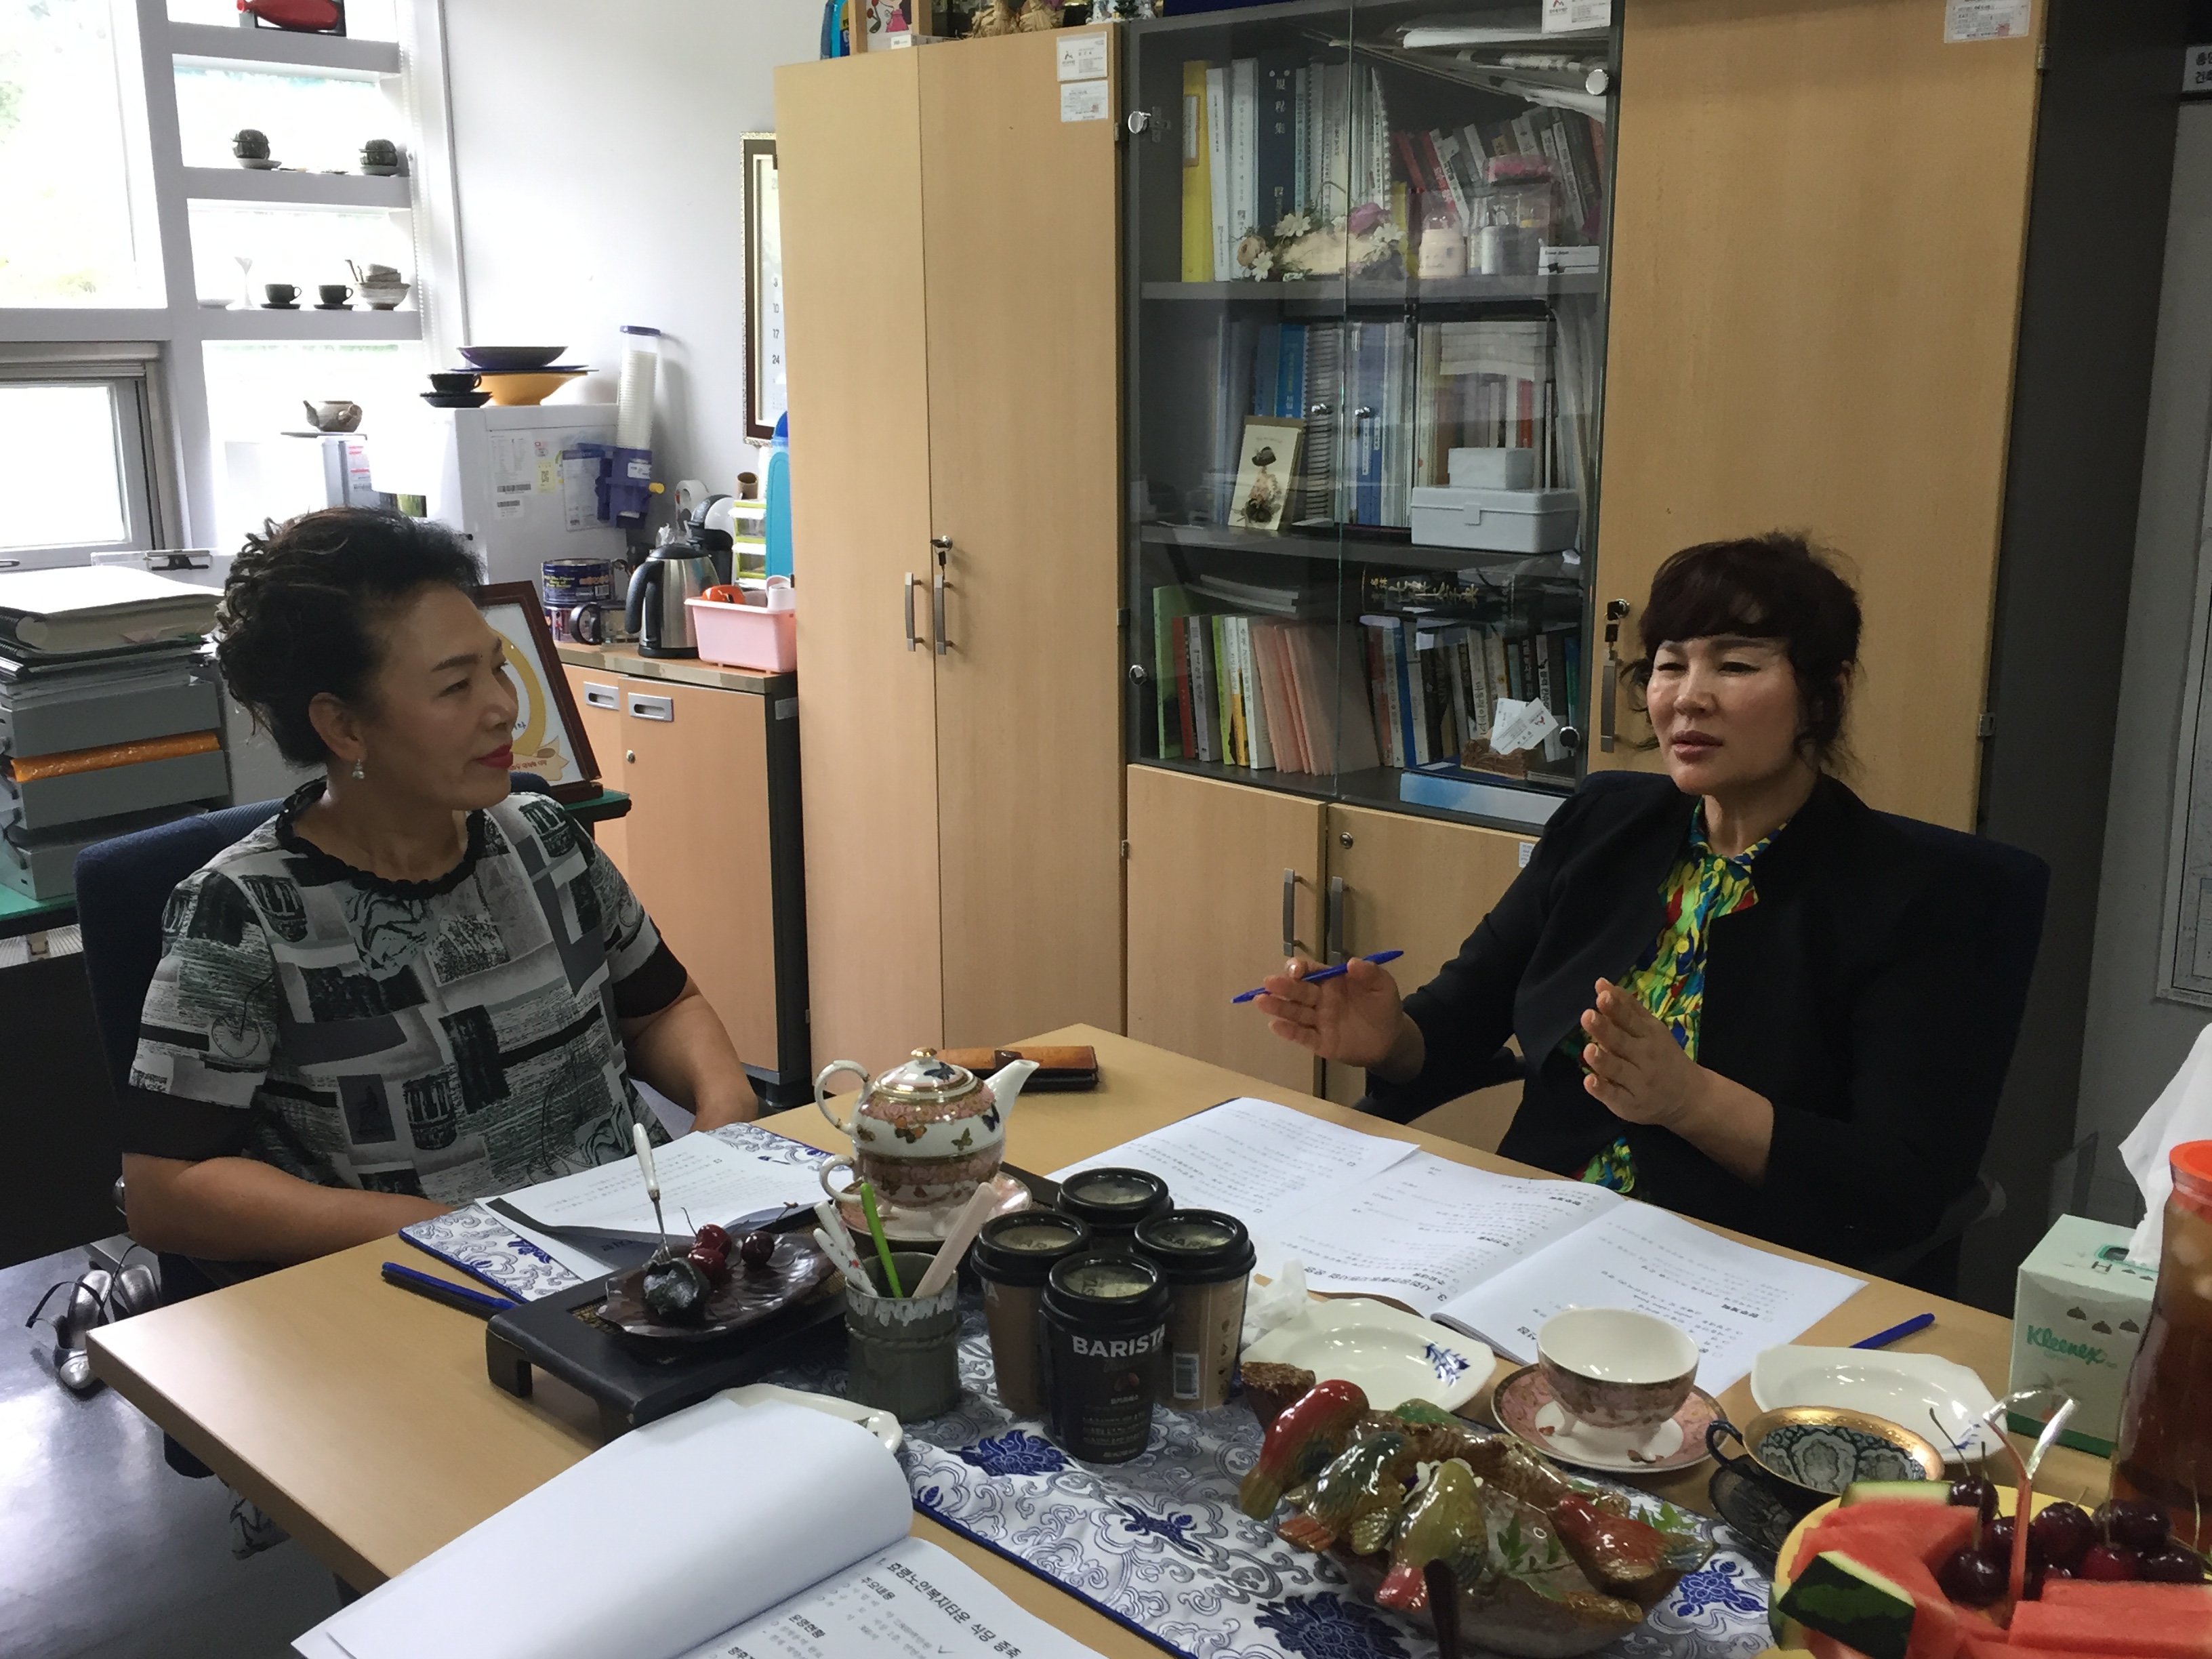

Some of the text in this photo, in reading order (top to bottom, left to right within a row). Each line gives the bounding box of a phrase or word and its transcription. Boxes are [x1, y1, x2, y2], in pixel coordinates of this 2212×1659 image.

[773, 329, 780, 340] 17
[772, 354, 780, 365] 24
[2026, 1324, 2106, 1364] Kleenex
[861, 1576, 896, 1601] 주요내용
[886, 1561, 971, 1624] 효령노인복지타운
[970, 1623, 997, 1642] 식당
[994, 1640, 1022, 1659] 증축
